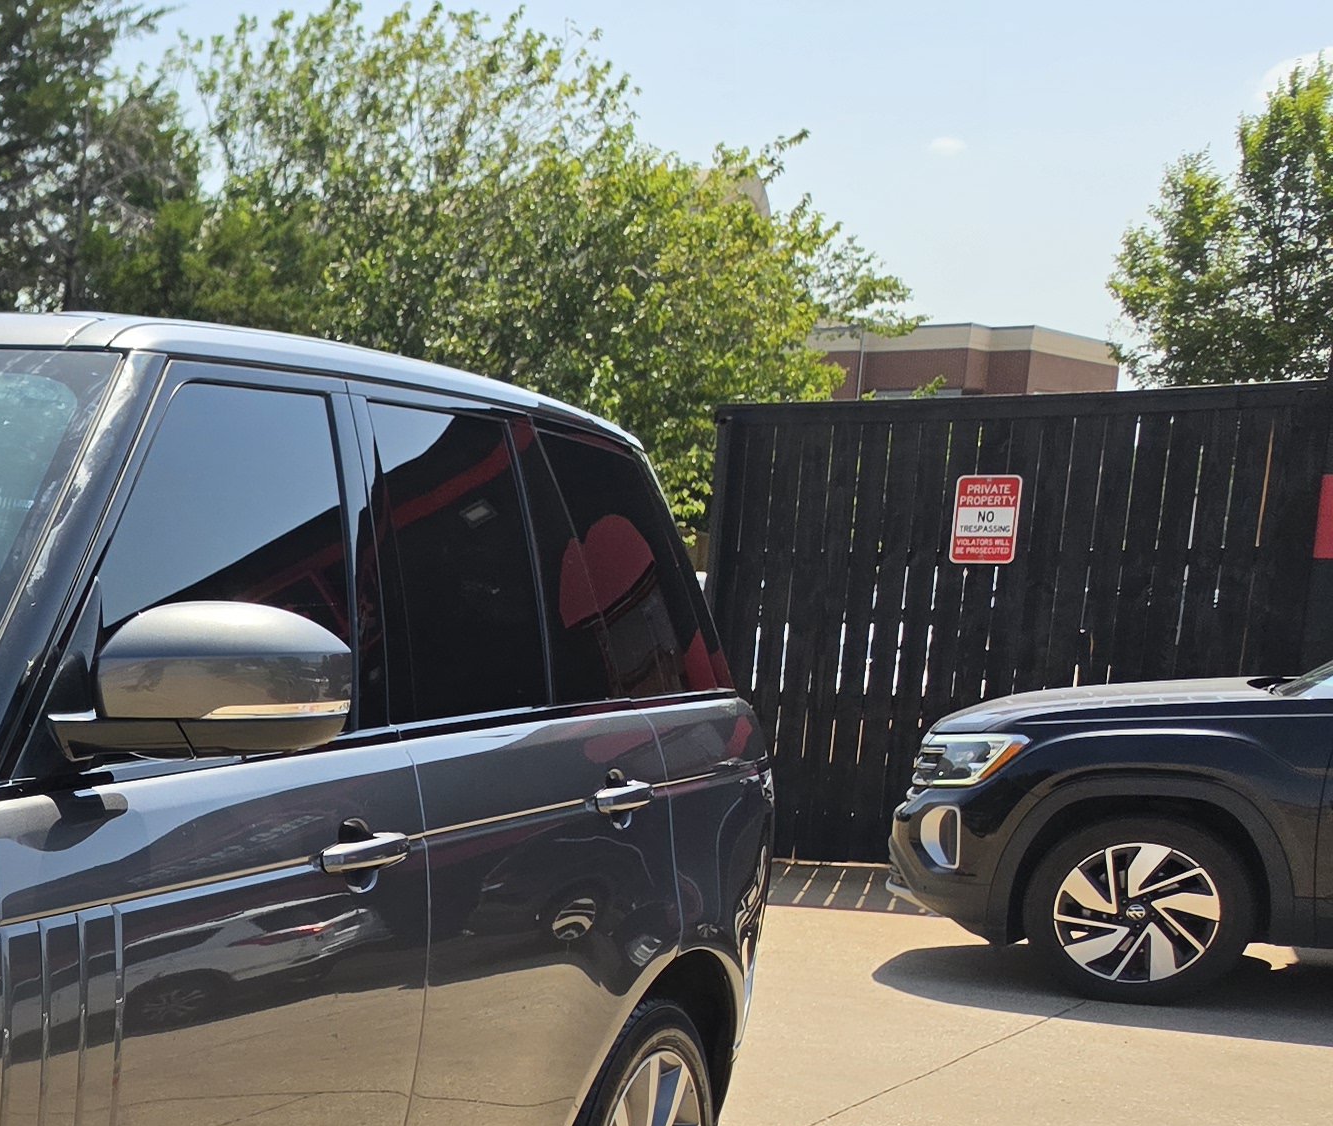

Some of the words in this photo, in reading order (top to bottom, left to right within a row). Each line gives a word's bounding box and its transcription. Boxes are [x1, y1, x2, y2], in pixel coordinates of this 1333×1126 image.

[966, 484, 1012, 494] PRIVATE
[959, 495, 1016, 506] PROPERTY
[977, 510, 994, 522] NO
[960, 524, 1010, 533] TRESPASSING
[956, 538, 993, 546] VIOLATORS
[994, 538, 1010, 546] WILL
[955, 546, 964, 554] BE
[966, 546, 1010, 554] PROSECUTED
